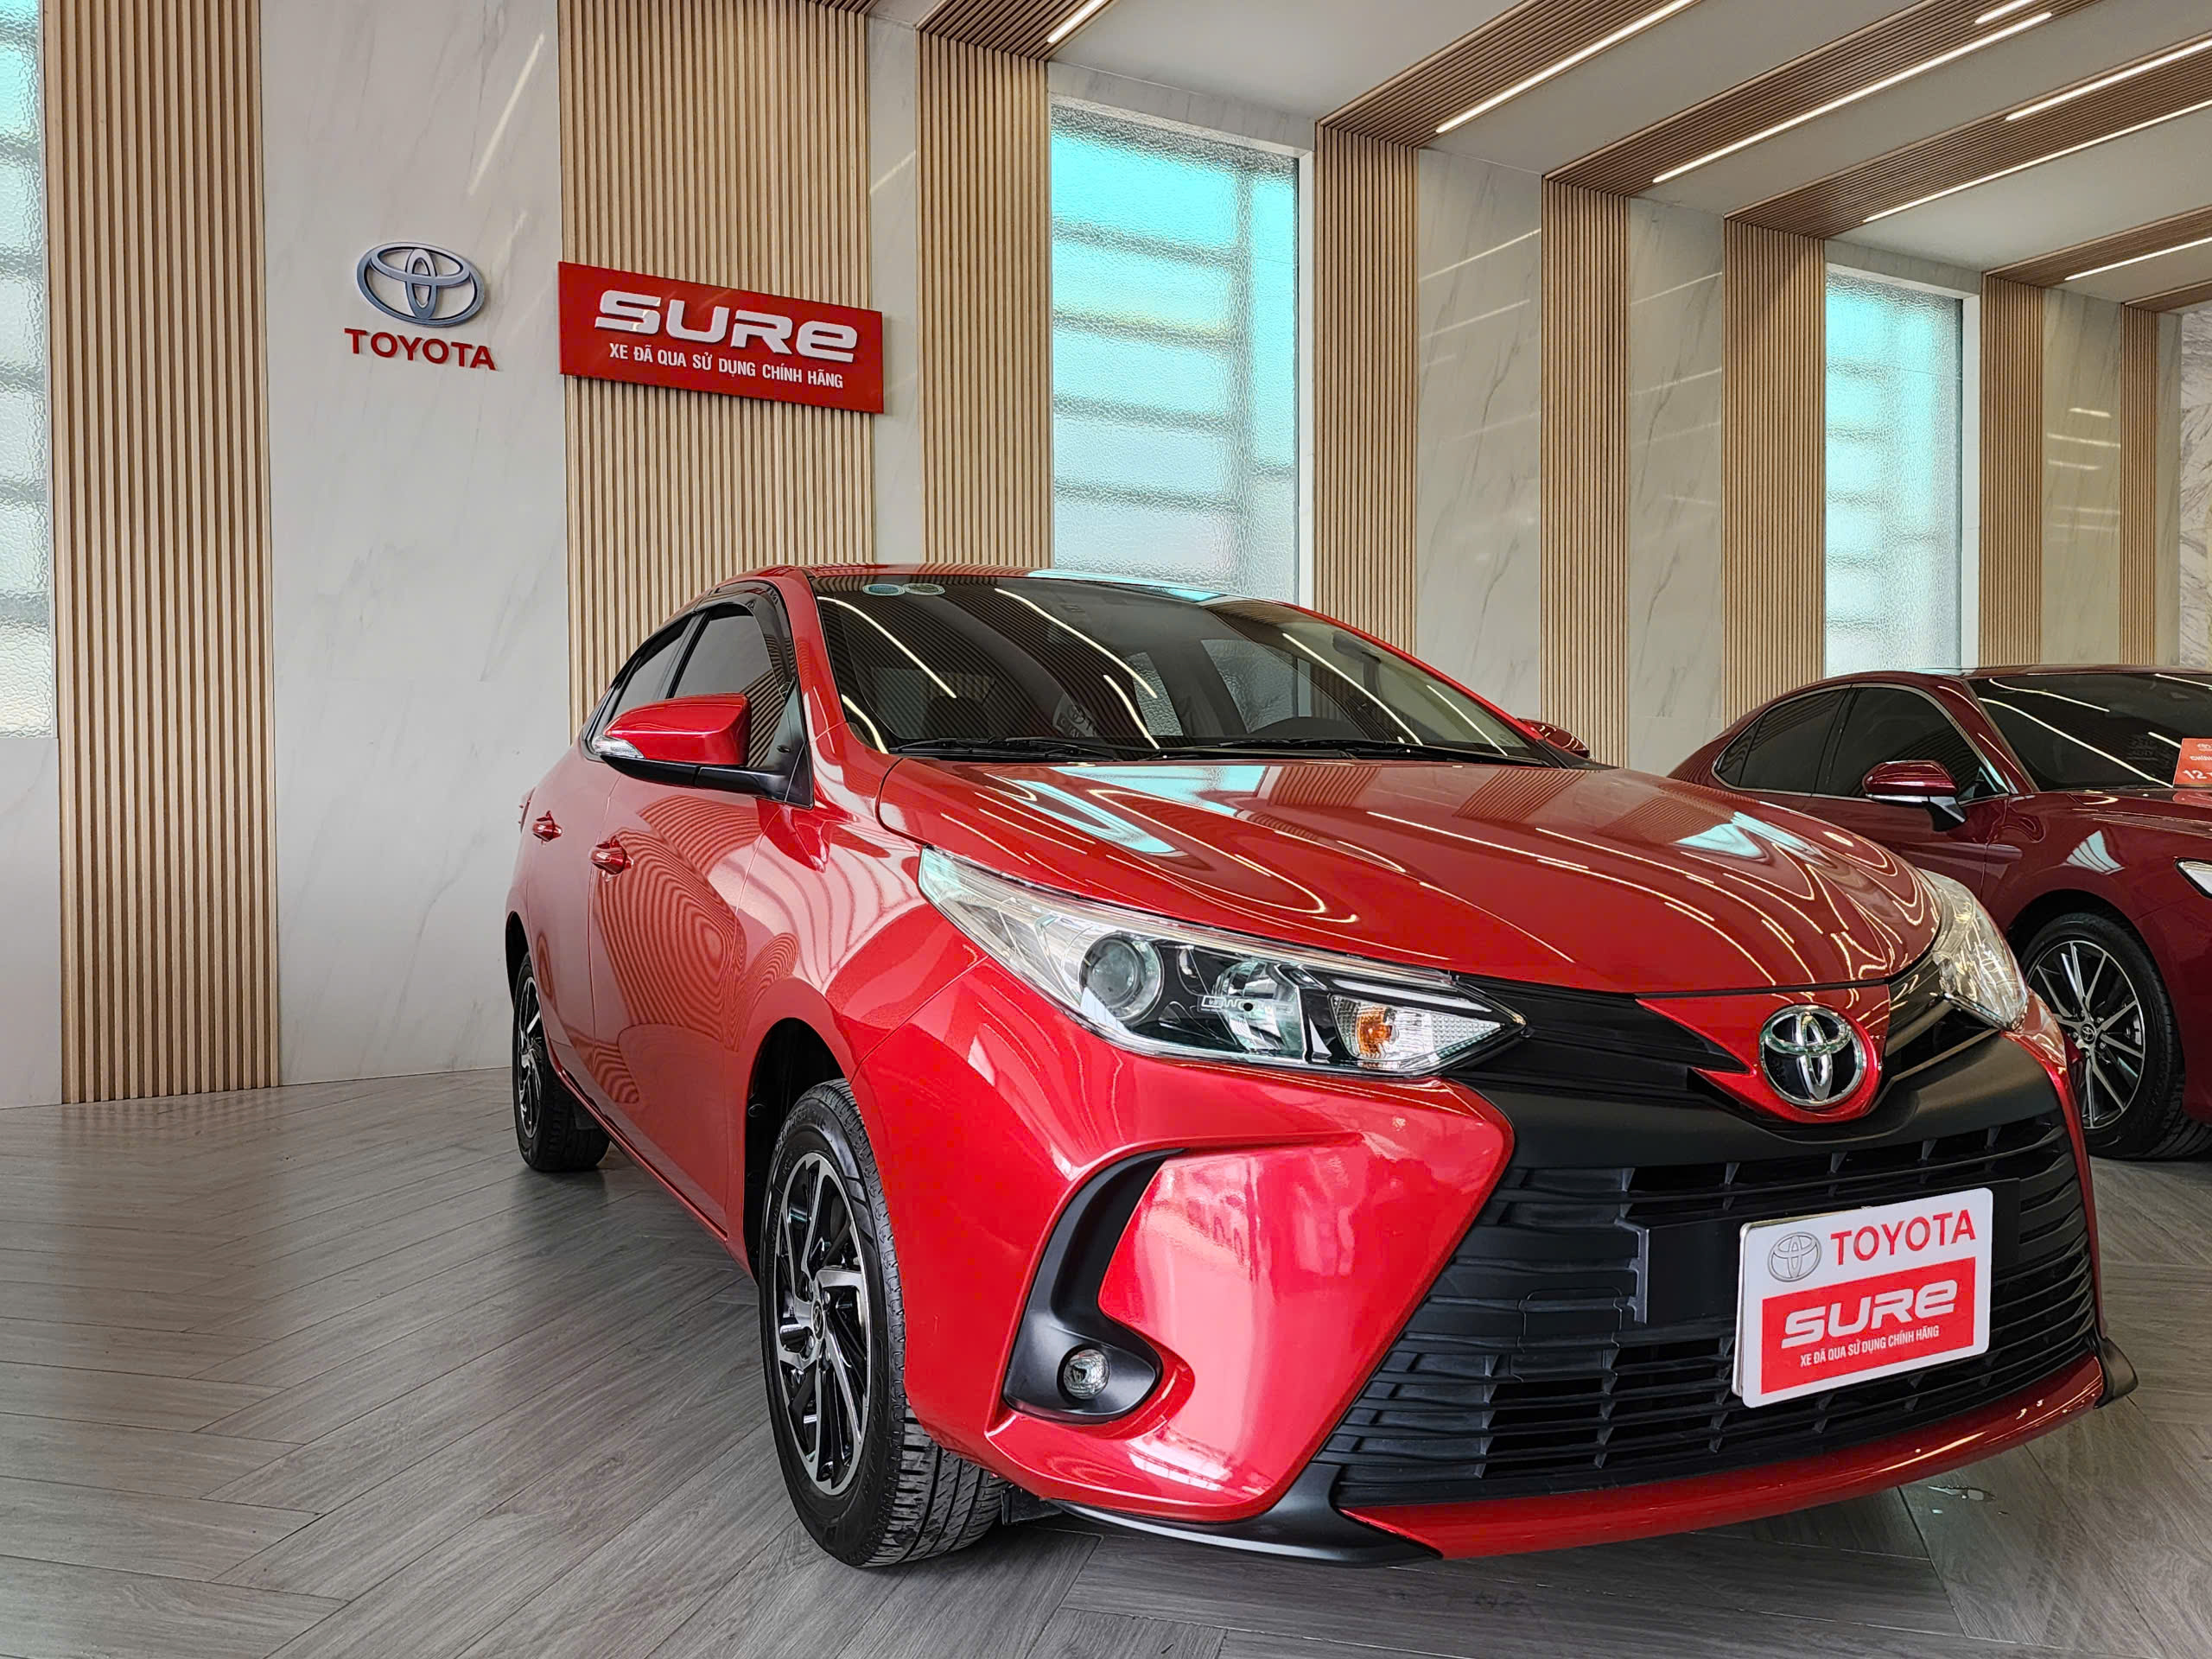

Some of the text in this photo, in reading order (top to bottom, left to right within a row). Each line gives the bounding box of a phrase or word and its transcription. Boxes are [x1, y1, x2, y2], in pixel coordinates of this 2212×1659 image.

[344, 327, 497, 371] TOYOTA
[609, 343, 844, 389] XE ĐÃ QUA SỬ DỤNG CHÍNH HÃNG
[1830, 1209, 1976, 1266] TOYOTA
[1800, 1325, 1939, 1367] XE ĐÃ QUA SỬ DỤNG CHÍNH HÃNG
